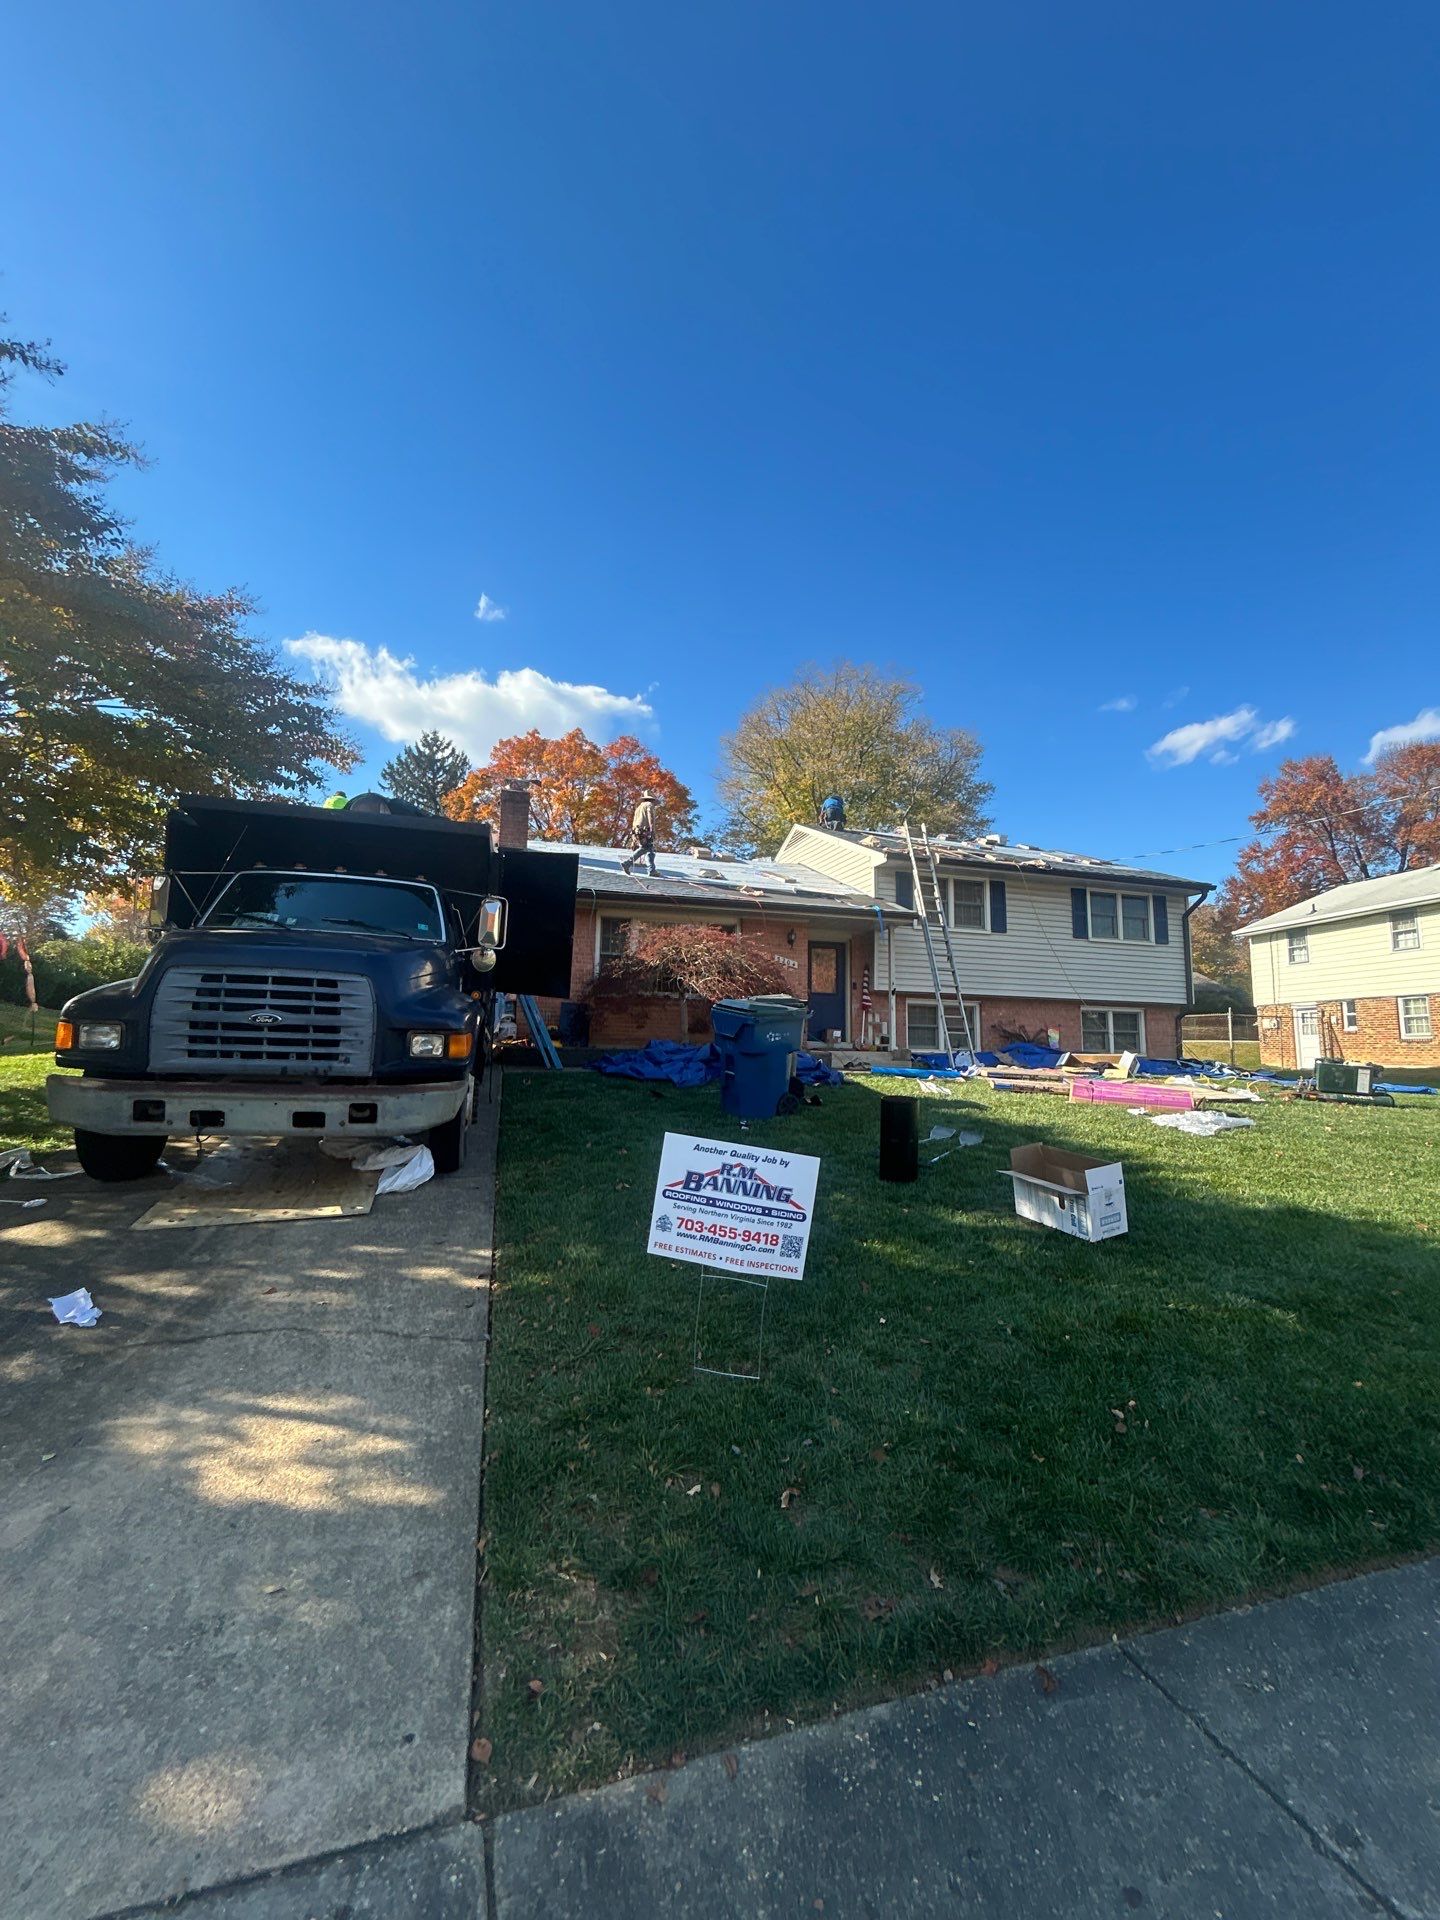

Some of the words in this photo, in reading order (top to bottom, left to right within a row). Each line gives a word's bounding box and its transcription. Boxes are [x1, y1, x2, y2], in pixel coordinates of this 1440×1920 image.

[693, 1143, 728, 1156] Another
[730, 1149, 760, 1163] Quality
[761, 1155, 777, 1165] Job
[779, 1160, 790, 1168] by
[719, 1162, 758, 1181] R.M.
[682, 1169, 794, 1203] BANNING
[665, 1190, 707, 1204] ROOFING
[715, 1199, 763, 1214] WINDOWS
[771, 1210, 803, 1220] SIDING
[672, 1202, 697, 1214] Serving
[698, 1207, 729, 1219] Northern
[730, 1213, 755, 1224] Virginia
[757, 1218, 774, 1227] Since
[776, 1221, 793, 1229] 1982
[676, 1231, 776, 1255] www.RMBanningCo.com
[653, 1241, 673, 1252] FREE
[675, 1245, 717, 1261] ESTIMATES
[725, 1256, 745, 1267] FREE
[746, 1260, 799, 1274] INSPECTIONS
